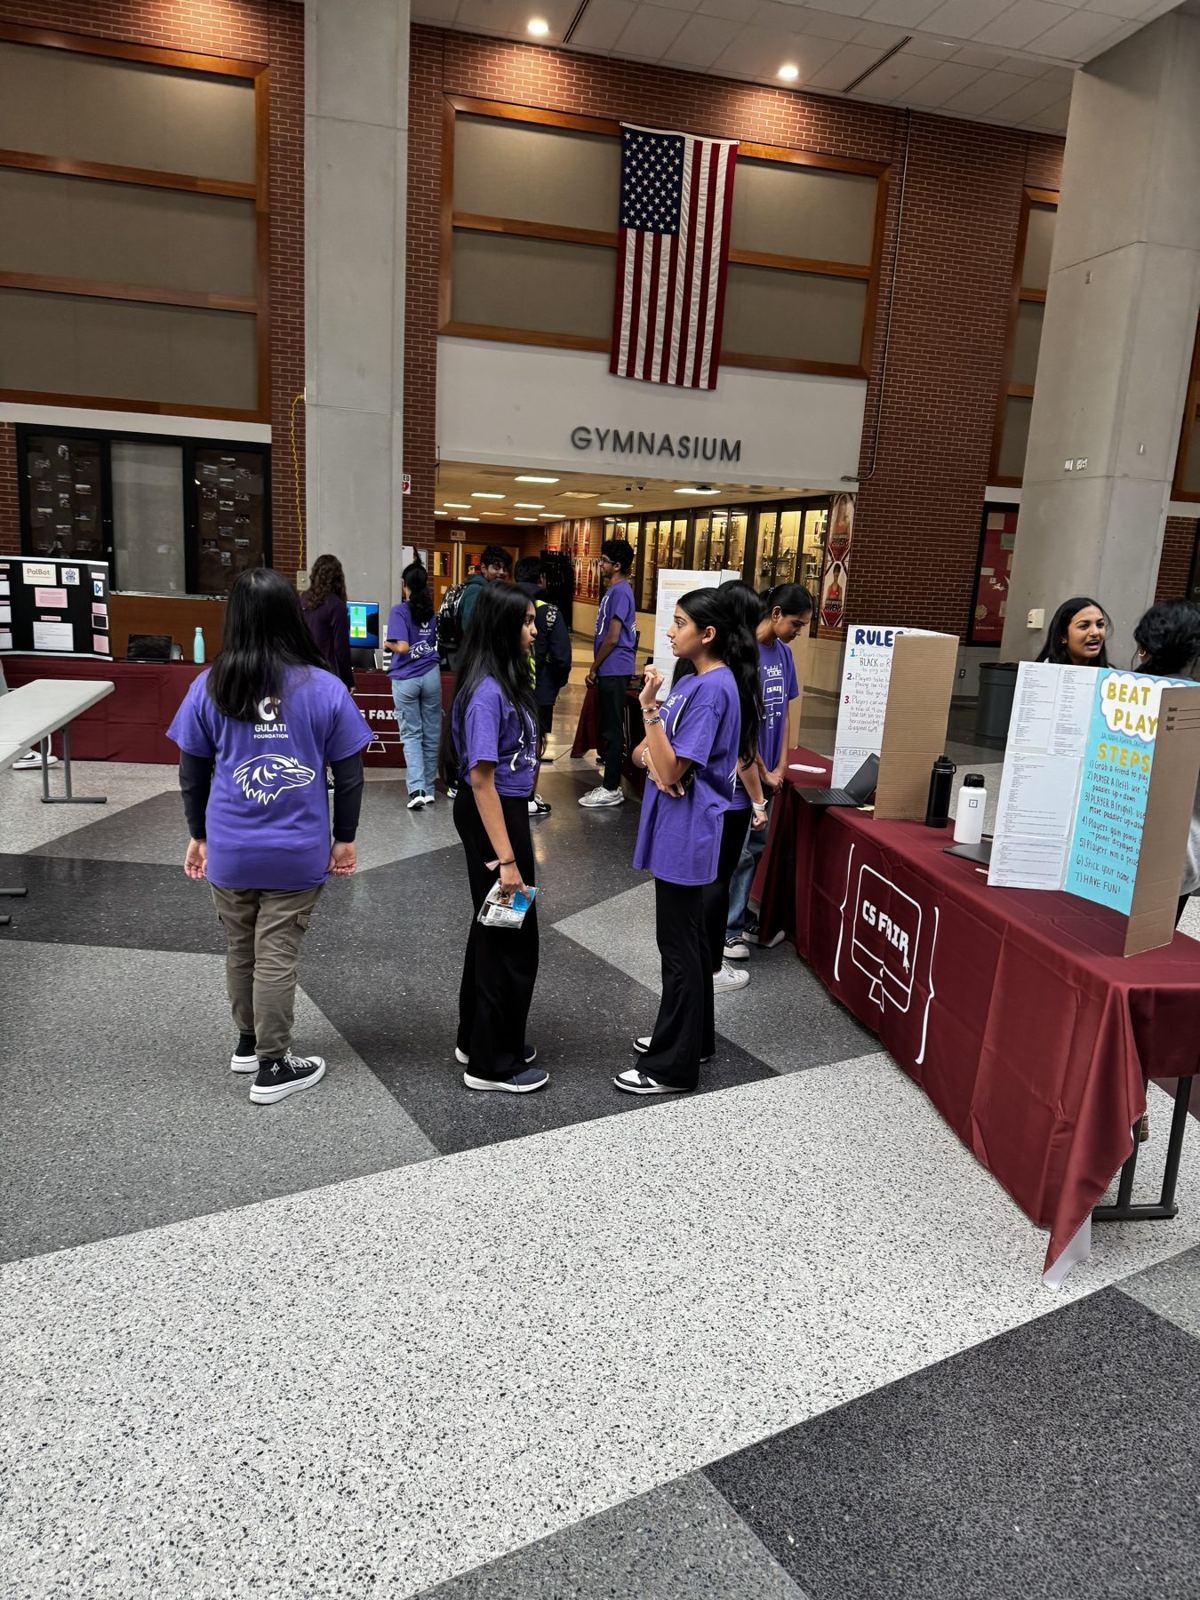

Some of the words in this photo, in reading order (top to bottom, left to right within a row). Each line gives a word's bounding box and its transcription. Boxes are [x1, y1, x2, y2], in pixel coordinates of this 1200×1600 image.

[570, 426, 742, 462] GYMNASIUM
[859, 657, 878, 668] BLACK
[1106, 681, 1151, 706] BEAT
[254, 723, 287, 733] GULATI
[1113, 708, 1158, 735] PLAY
[1097, 742, 1151, 773] STEPS
[862, 899, 877, 927] CS
[878, 911, 910, 951] FAIR
